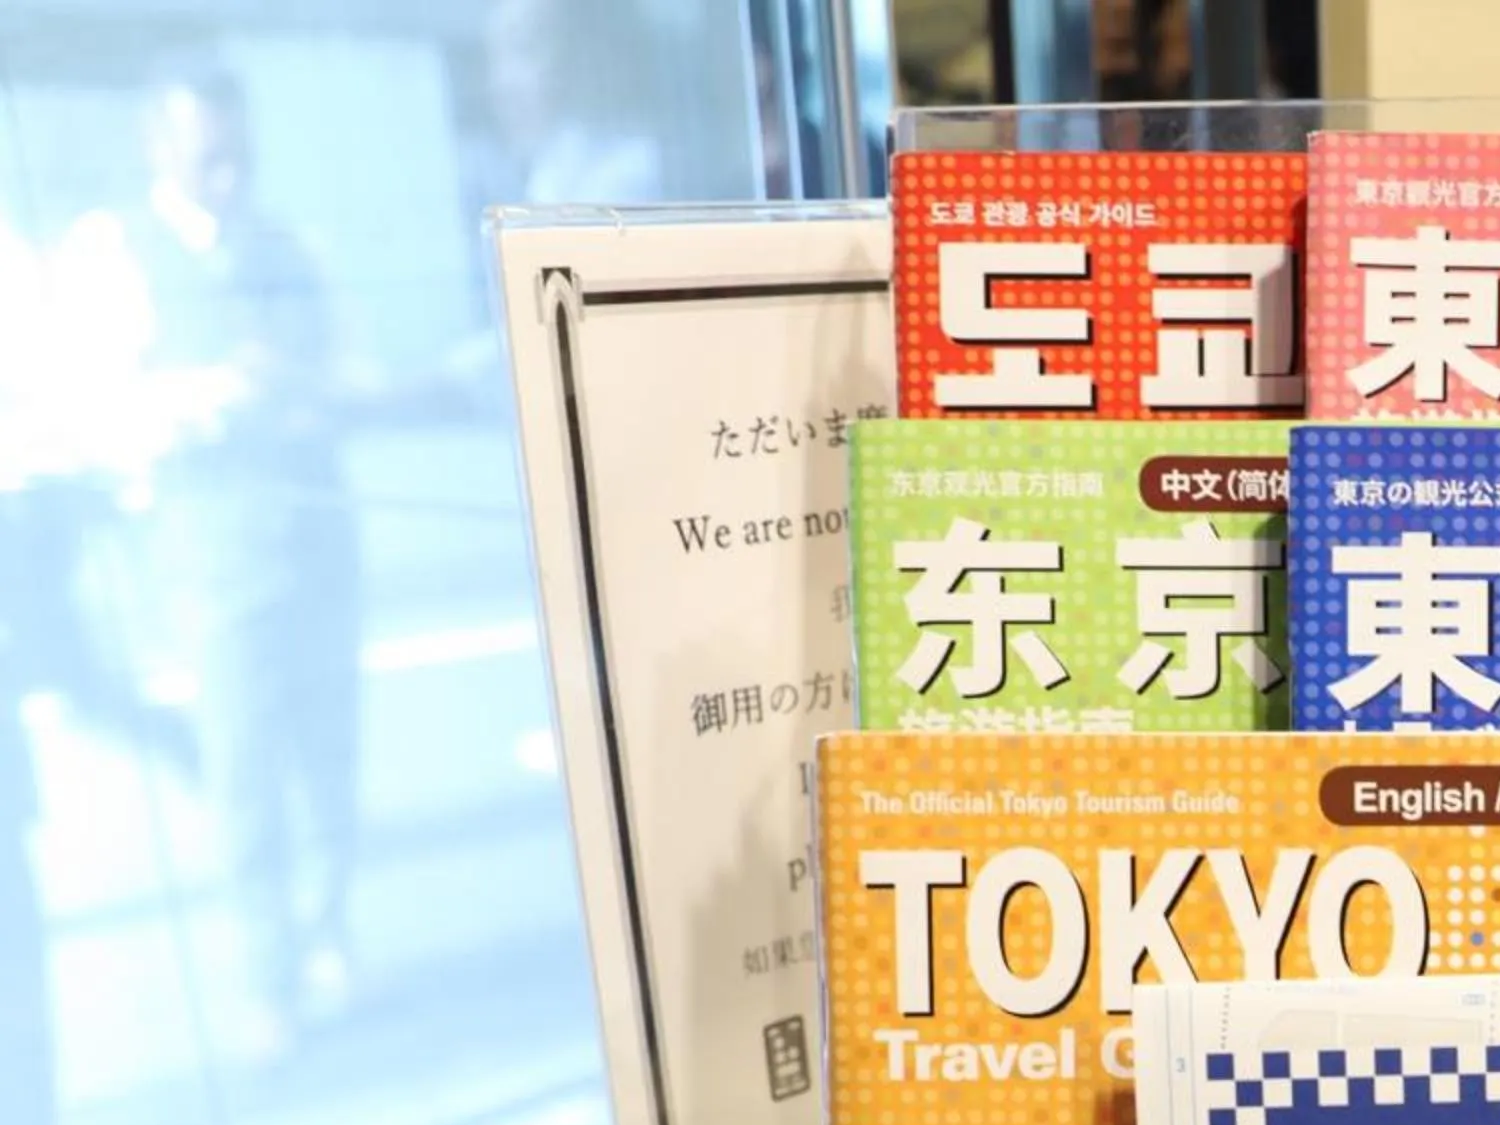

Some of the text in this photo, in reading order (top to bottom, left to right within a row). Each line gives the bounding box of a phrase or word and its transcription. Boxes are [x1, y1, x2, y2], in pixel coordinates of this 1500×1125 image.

[930, 200, 1161, 228] 도쿄 관광 공식 가이드
[673, 515, 731, 554] We
[743, 516, 793, 545] are
[893, 515, 1287, 699] 东京
[861, 788, 1240, 819] The Official Tokyo Tourism Guide
[1353, 780, 1486, 821] English
[859, 844, 1430, 1018] TOKYO
[872, 1027, 1076, 1082] Travel
